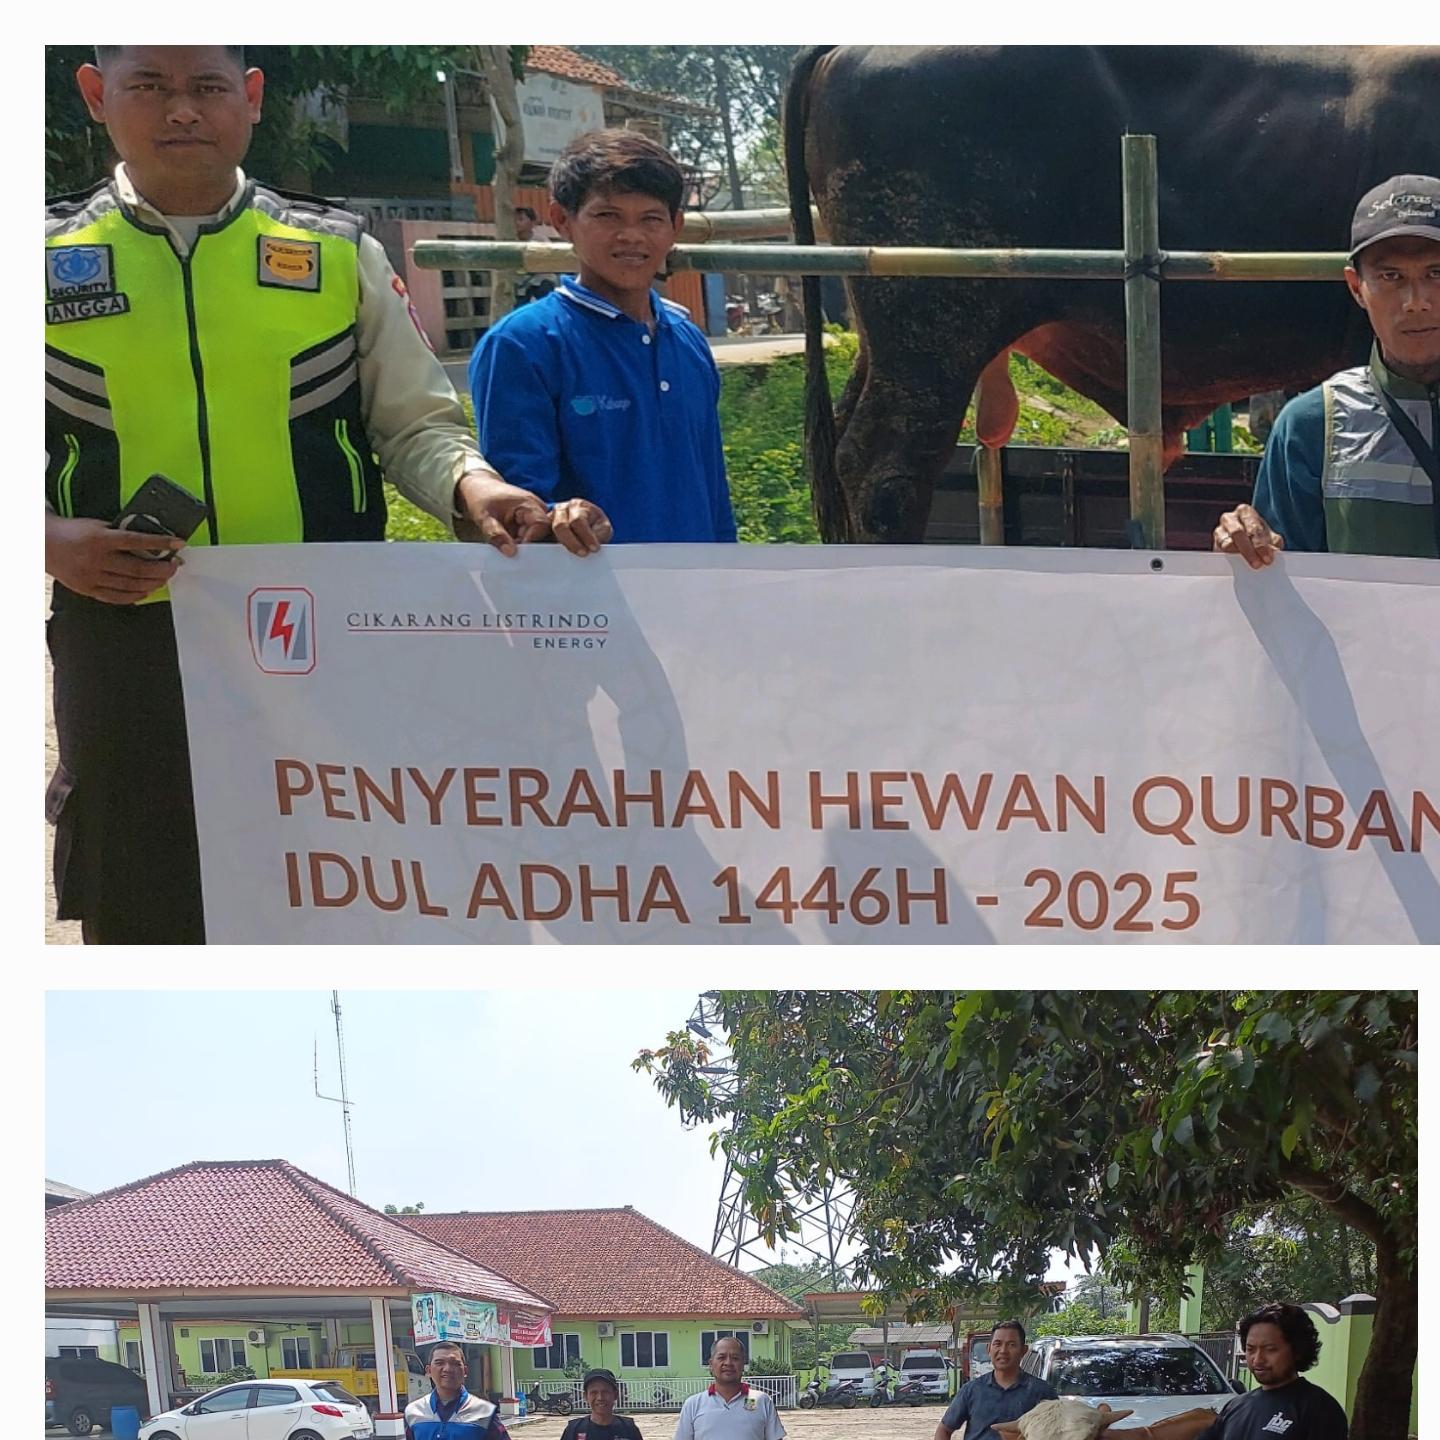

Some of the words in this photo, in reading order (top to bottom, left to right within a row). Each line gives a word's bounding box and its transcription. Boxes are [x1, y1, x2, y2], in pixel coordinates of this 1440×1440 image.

[51, 281, 109, 298] SECURITY
[51, 298, 122, 321] ANGGA
[347, 613, 472, 629] CIKARANG
[483, 613, 610, 629] LISTRINDO
[533, 637, 609, 649] ENERGY
[274, 758, 780, 831] PENYERAHAN
[809, 770, 1106, 834] HEWAN
[284, 851, 449, 918] IDUL
[466, 862, 691, 925] ADHA
[712, 865, 949, 926] 1446H
[1023, 868, 1202, 933] 2025
